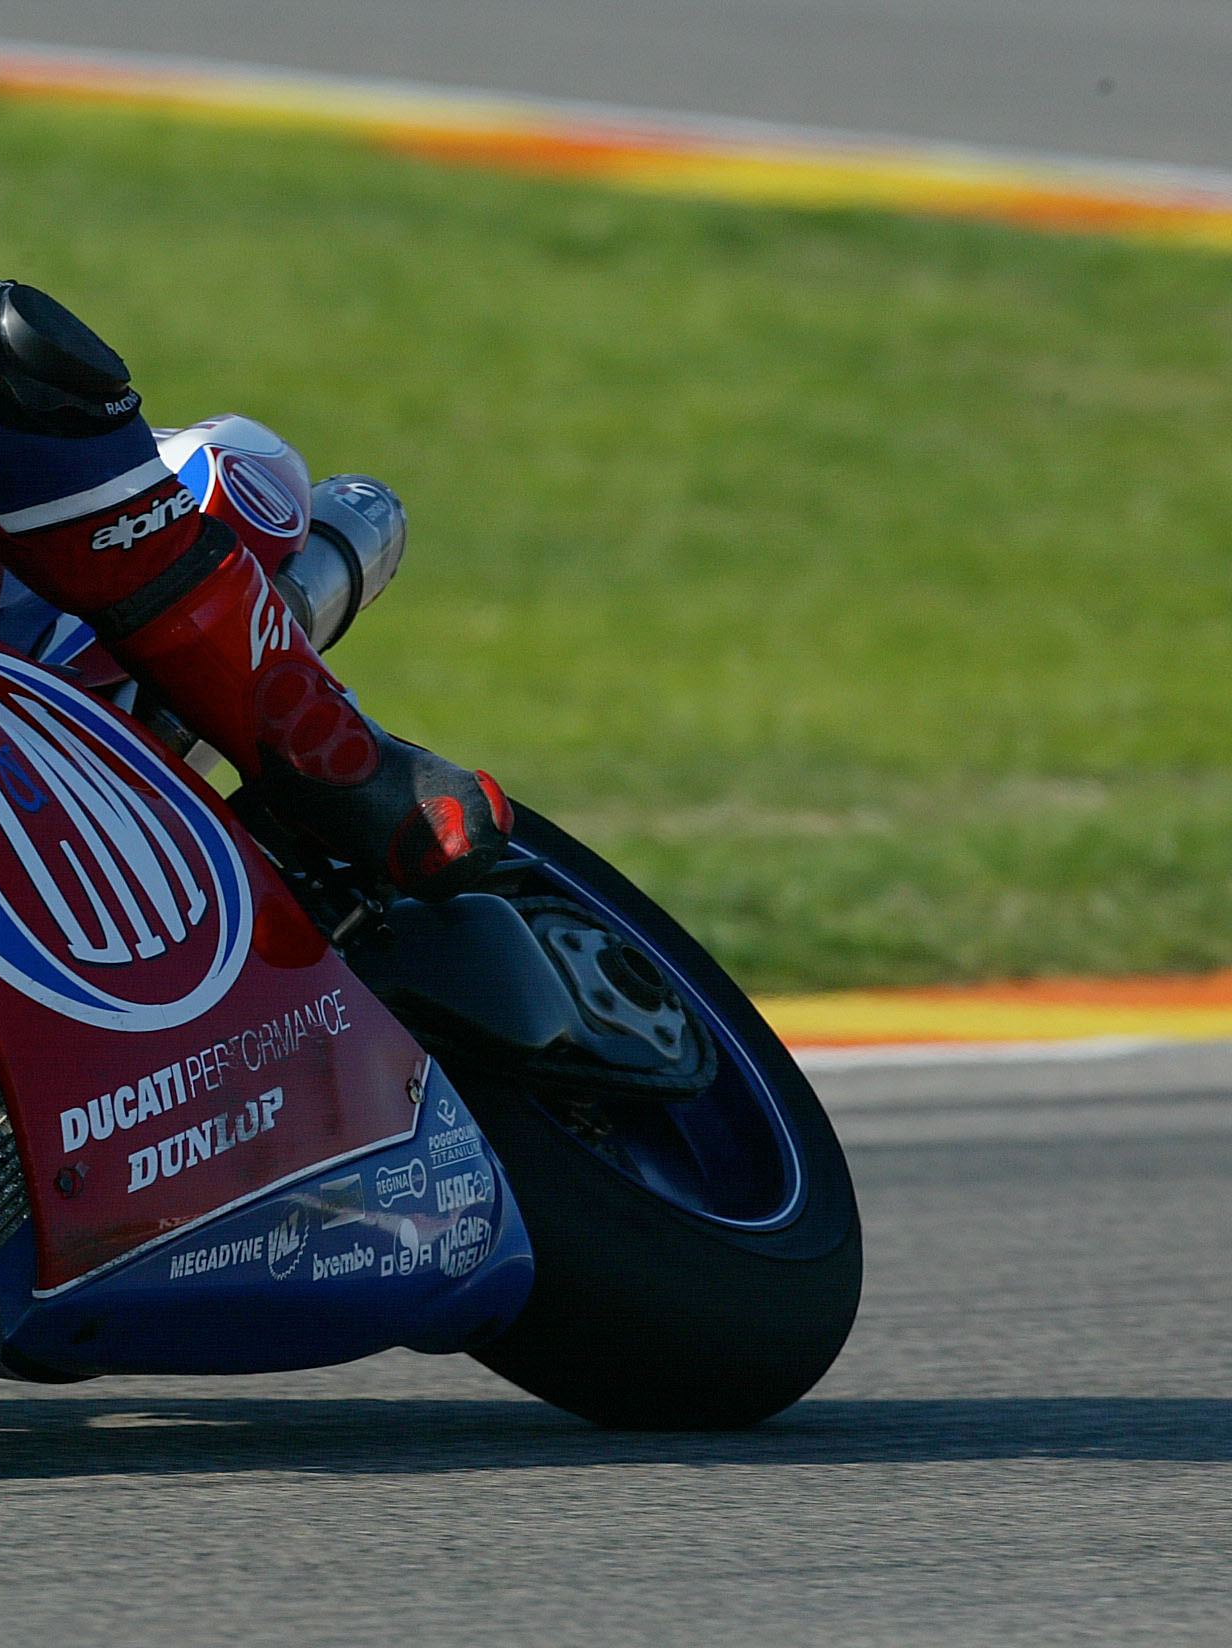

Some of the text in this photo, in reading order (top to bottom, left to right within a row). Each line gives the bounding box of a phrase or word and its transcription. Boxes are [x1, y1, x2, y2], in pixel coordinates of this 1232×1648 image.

[60, 988, 352, 1153] DUCATI PERORMANCE
[127, 1086, 284, 1194] DUNLOP
[430, 1140, 482, 1166] TITANIUM
[376, 1173, 410, 1196] REGINA
[435, 1172, 475, 1213] USAG
[169, 1235, 265, 1280] MEGADYNE
[312, 1242, 375, 1282] brembo
